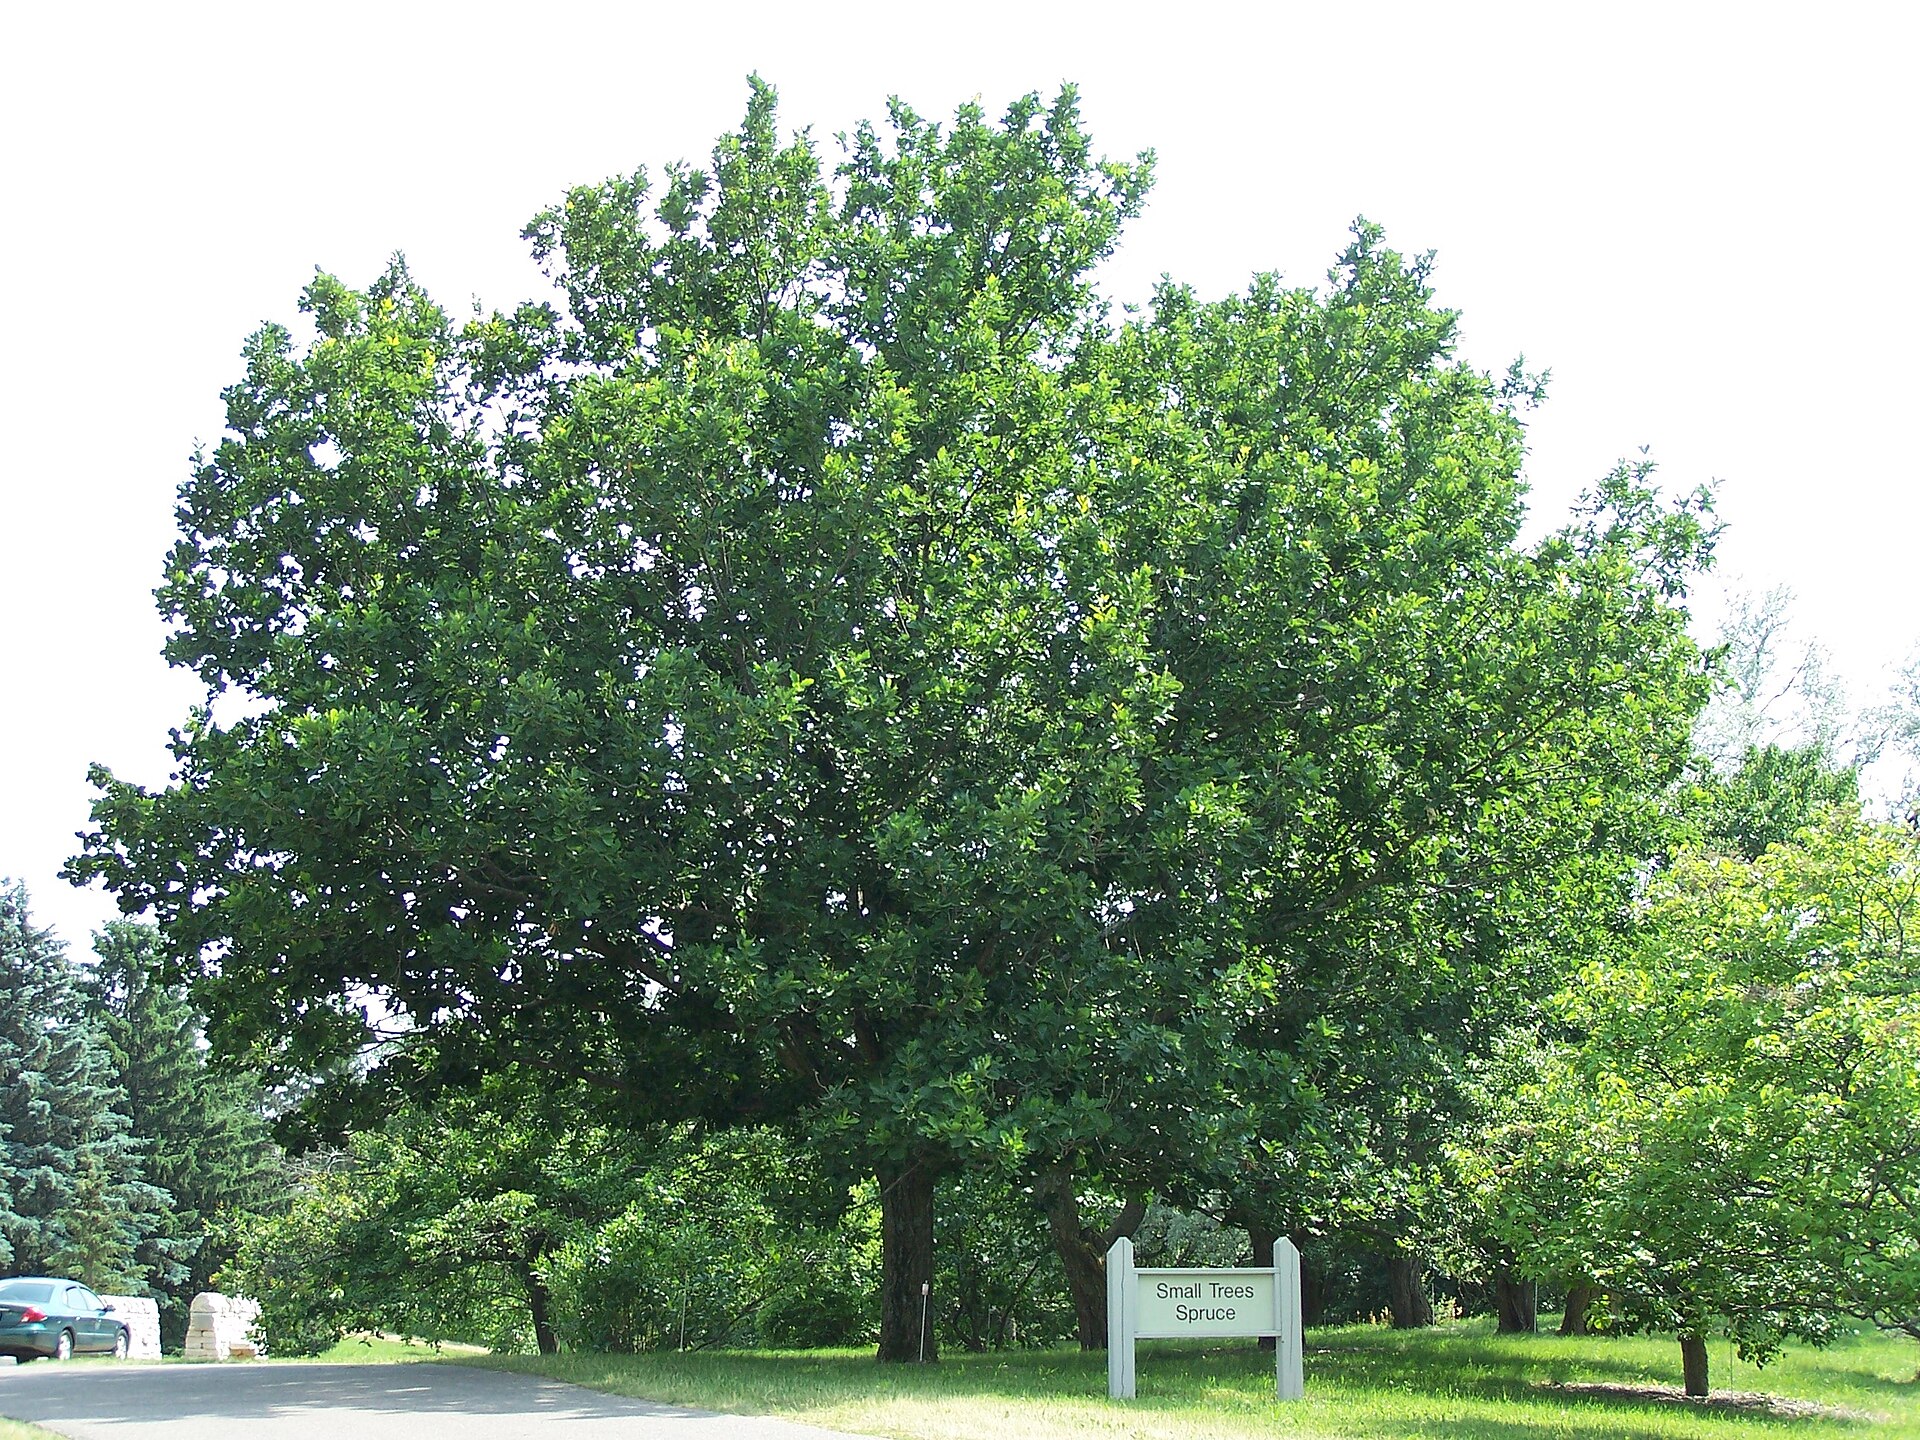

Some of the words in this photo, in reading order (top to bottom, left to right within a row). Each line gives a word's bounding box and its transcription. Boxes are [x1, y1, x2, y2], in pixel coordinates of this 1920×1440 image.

[1156, 1282, 1202, 1299] Small
[1208, 1282, 1254, 1299] Trees
[1175, 1304, 1236, 1324] Spruce
